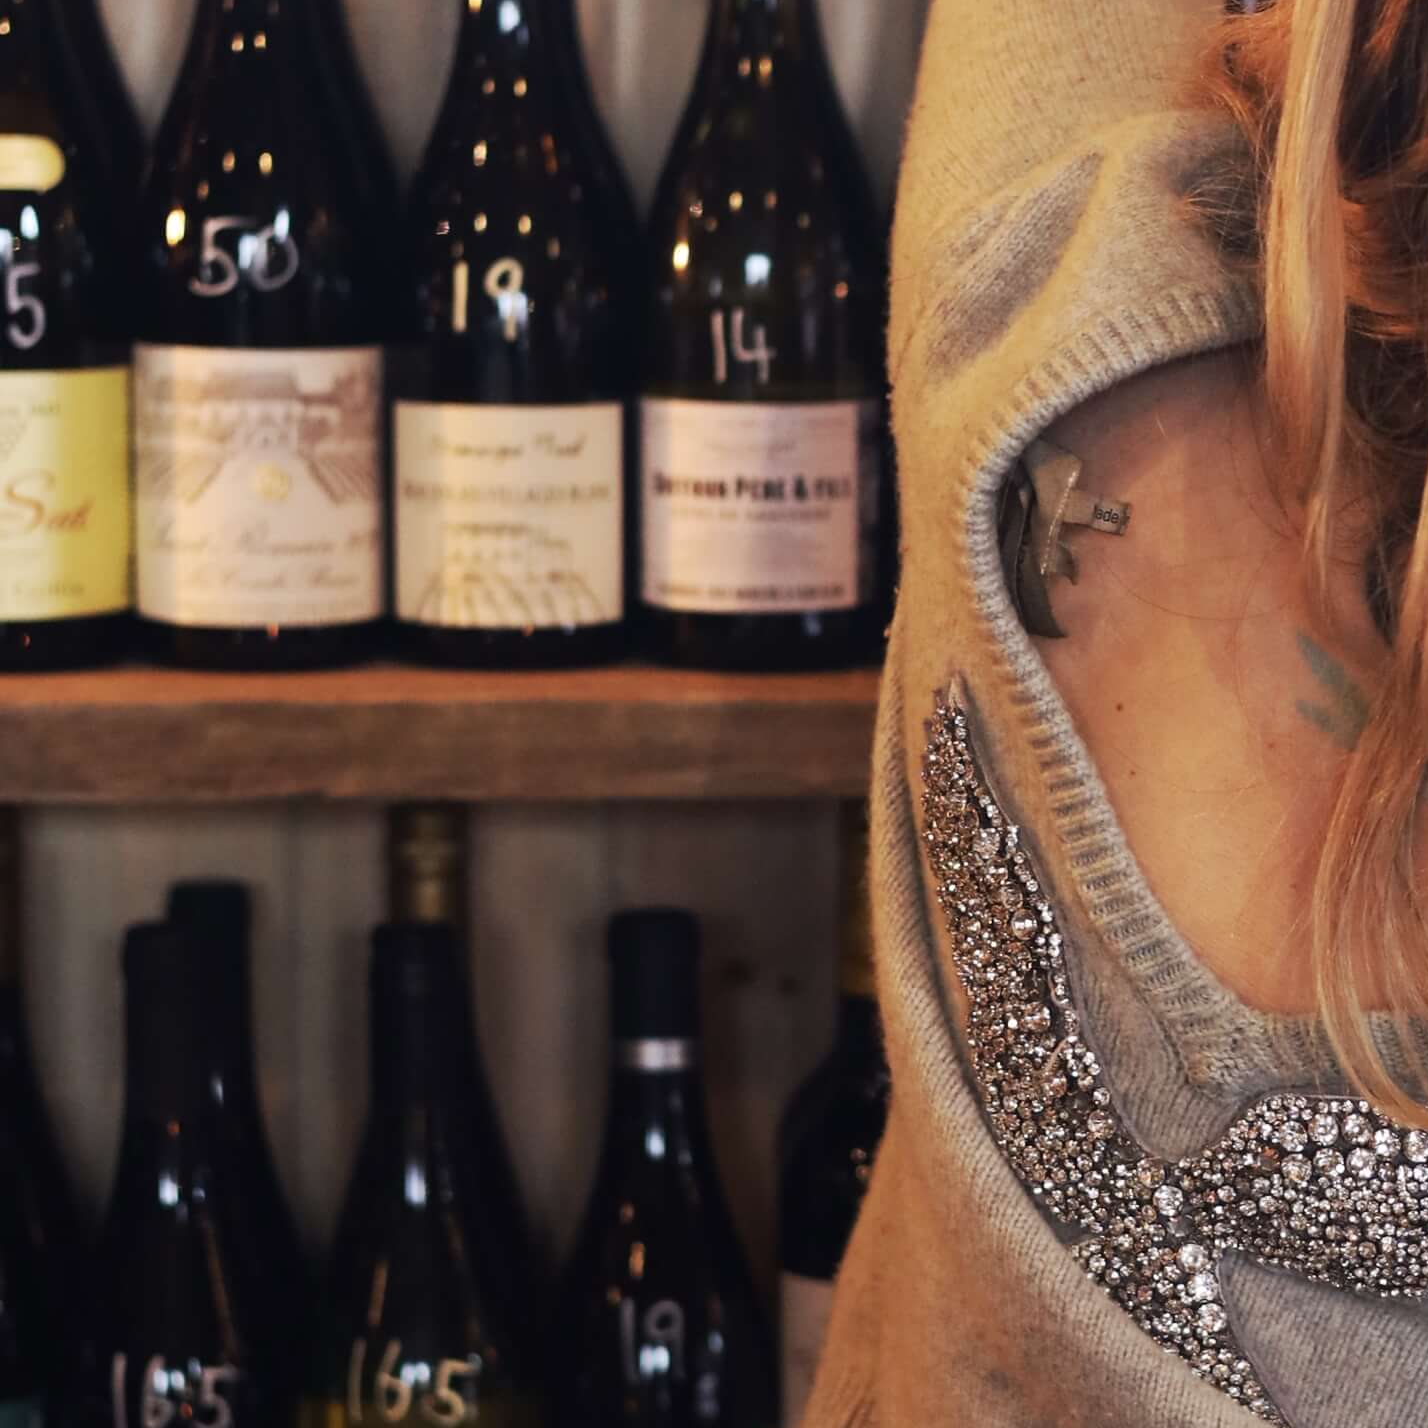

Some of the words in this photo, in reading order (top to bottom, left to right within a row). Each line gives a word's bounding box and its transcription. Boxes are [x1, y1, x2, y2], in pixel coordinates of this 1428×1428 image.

[190, 216, 299, 296] 50
[453, 257, 524, 342] 19
[711, 307, 775, 384] 14
[620, 1297, 685, 1384] 19
